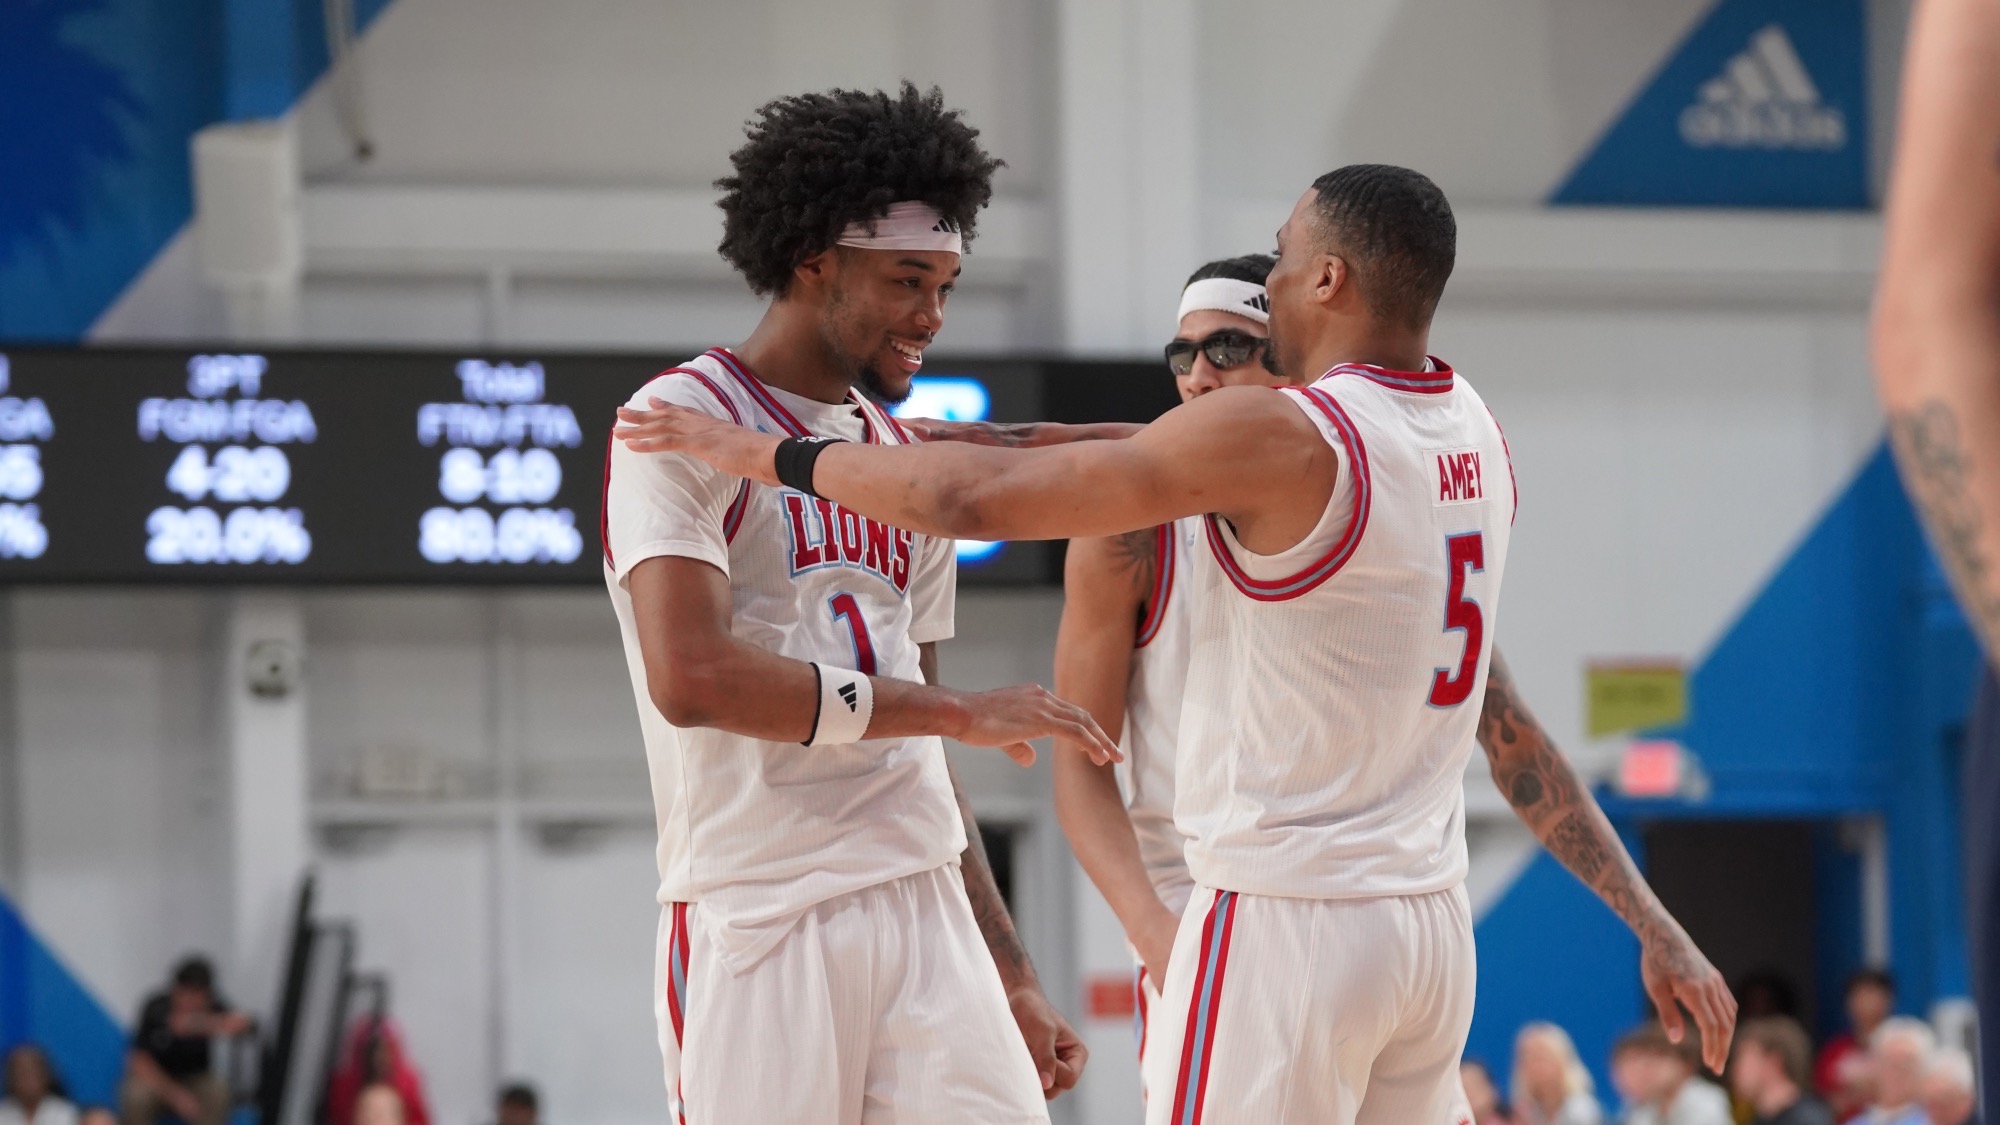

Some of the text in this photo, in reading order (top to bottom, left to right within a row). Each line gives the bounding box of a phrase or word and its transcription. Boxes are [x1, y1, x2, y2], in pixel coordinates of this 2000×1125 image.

[187, 354, 268, 398] 3PT
[456, 360, 545, 403] Total
[138, 398, 317, 443] FGM-FGA
[166, 445, 291, 502] 4-20
[439, 447, 562, 504] 8-10
[1437, 452, 1483, 502] AMEY
[145, 506, 312, 564] 20.0%
[419, 507, 583, 564] 80.0%
[780, 491, 915, 598] LIONS
[828, 591, 877, 676] 1
[1426, 530, 1485, 710] 5
